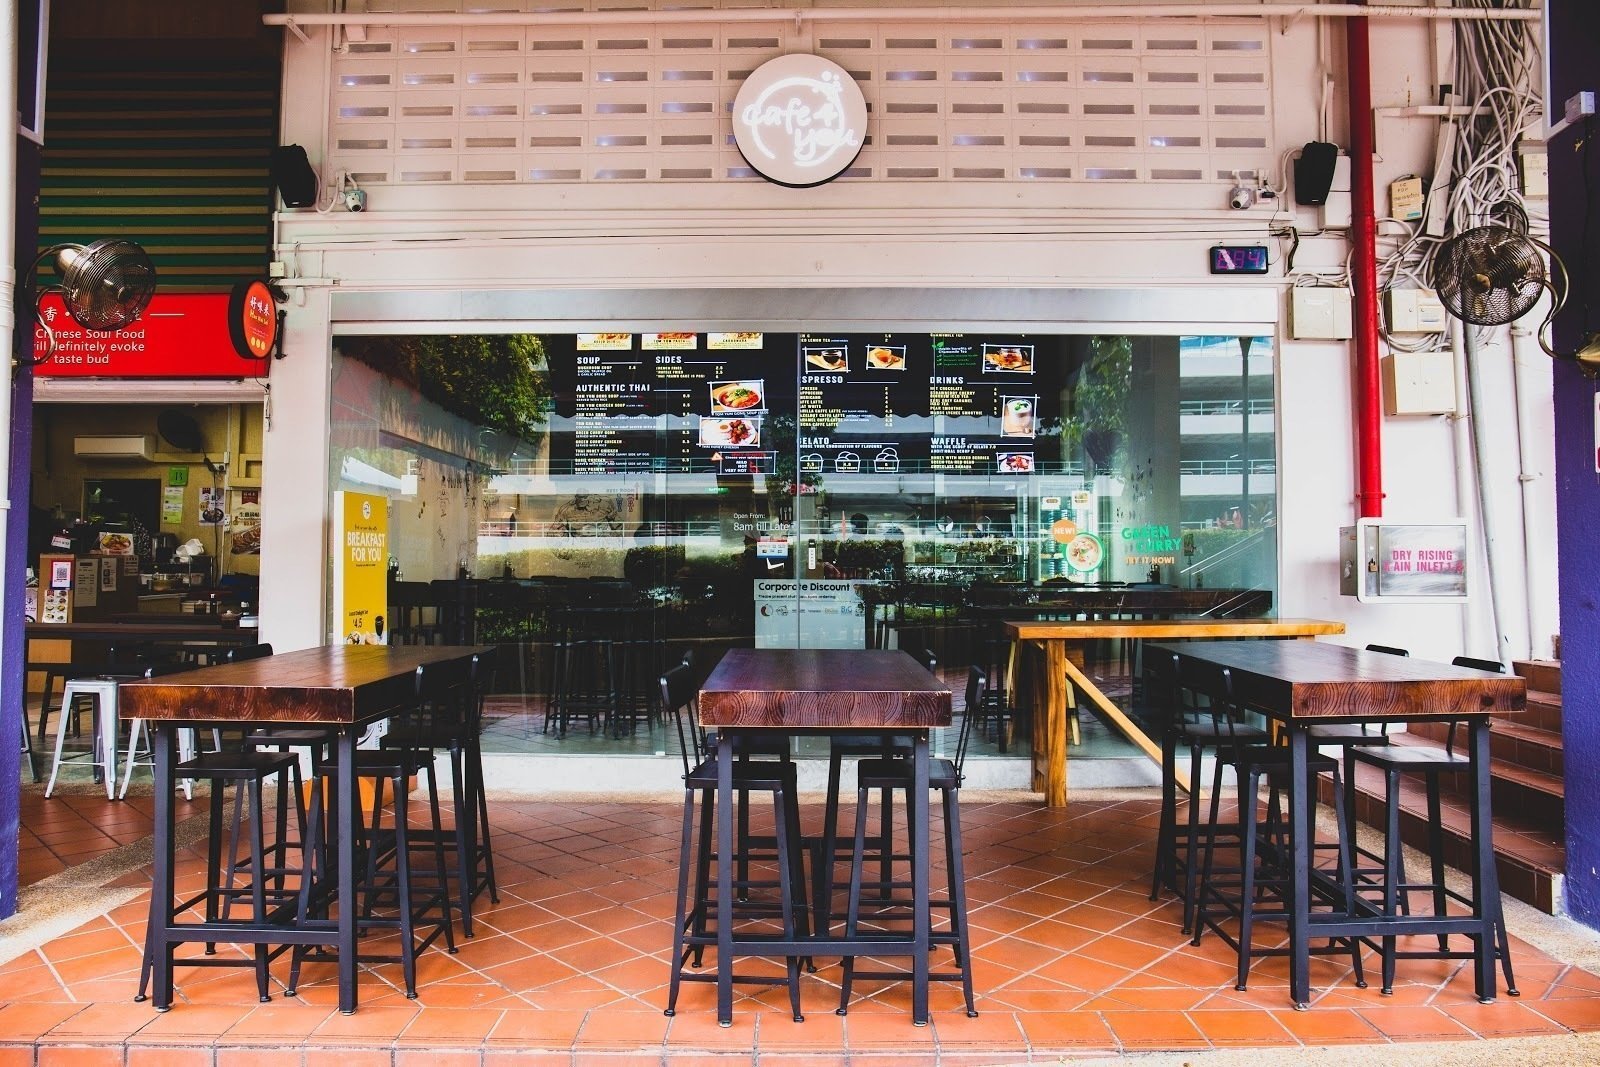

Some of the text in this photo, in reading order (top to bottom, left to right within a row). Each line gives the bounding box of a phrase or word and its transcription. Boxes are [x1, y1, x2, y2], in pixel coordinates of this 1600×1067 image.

[116, 330, 144, 338] Food
[110, 341, 144, 351] evoke
[87, 354, 109, 364] bud
[733, 522, 753, 531] 8am
[757, 522, 767, 531] till
[1122, 526, 1169, 539] GREEN
[348, 531, 385, 547] BREAKFAST
[1136, 538, 1182, 553] CURRY
[352, 547, 382, 561] FOR YOU
[1393, 550, 1452, 560] DRY RISING
[1417, 561, 1443, 571] INLET
[810, 583, 850, 592] Discount
